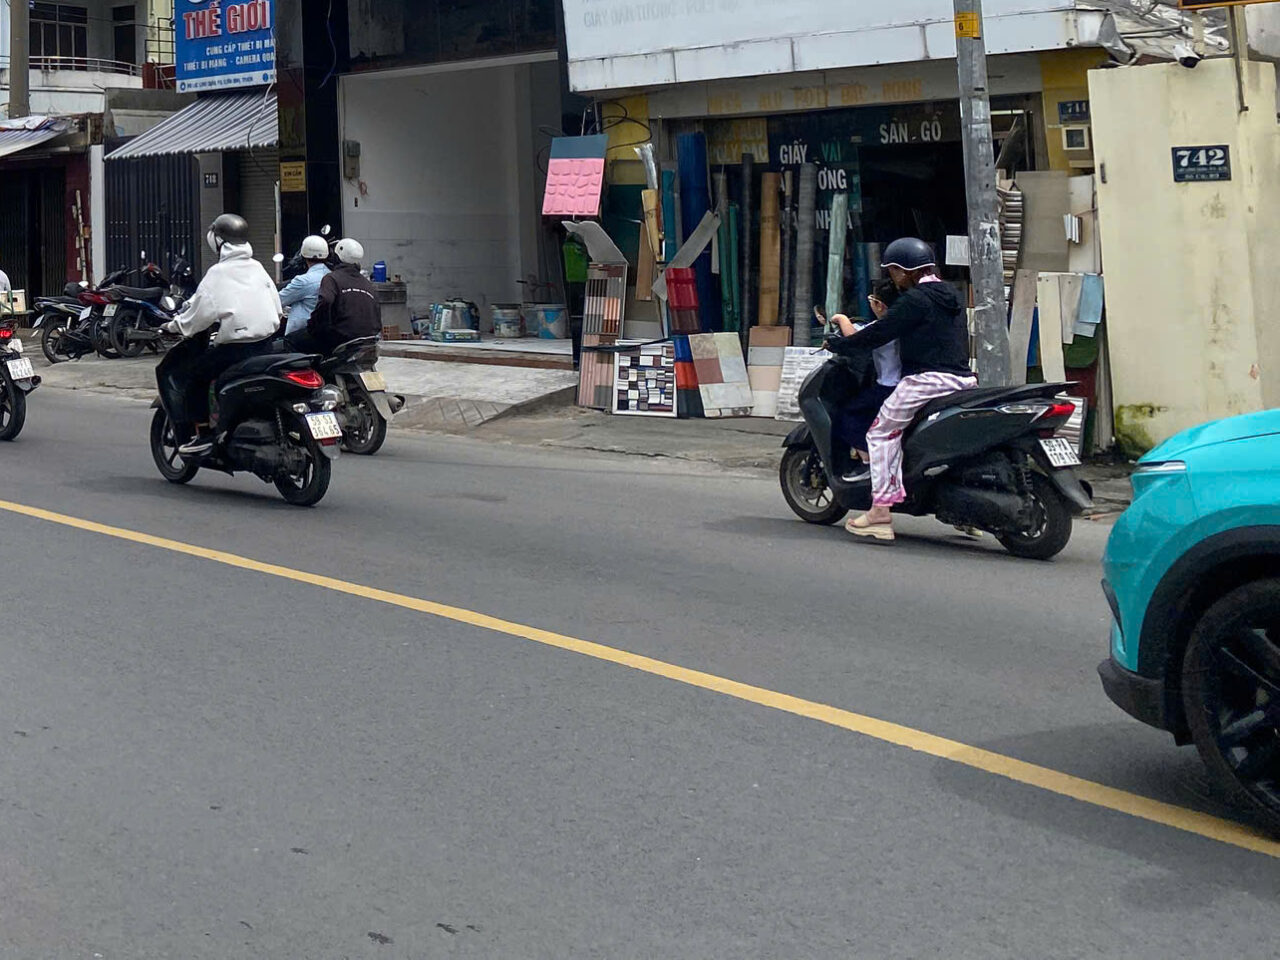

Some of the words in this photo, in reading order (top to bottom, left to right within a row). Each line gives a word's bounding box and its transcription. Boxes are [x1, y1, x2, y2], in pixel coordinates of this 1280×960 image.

[880, 117, 909, 144] SÀN
[921, 110, 942, 141] GỖ
[780, 138, 807, 165] GIẤY
[1176, 148, 1226, 167] 742
